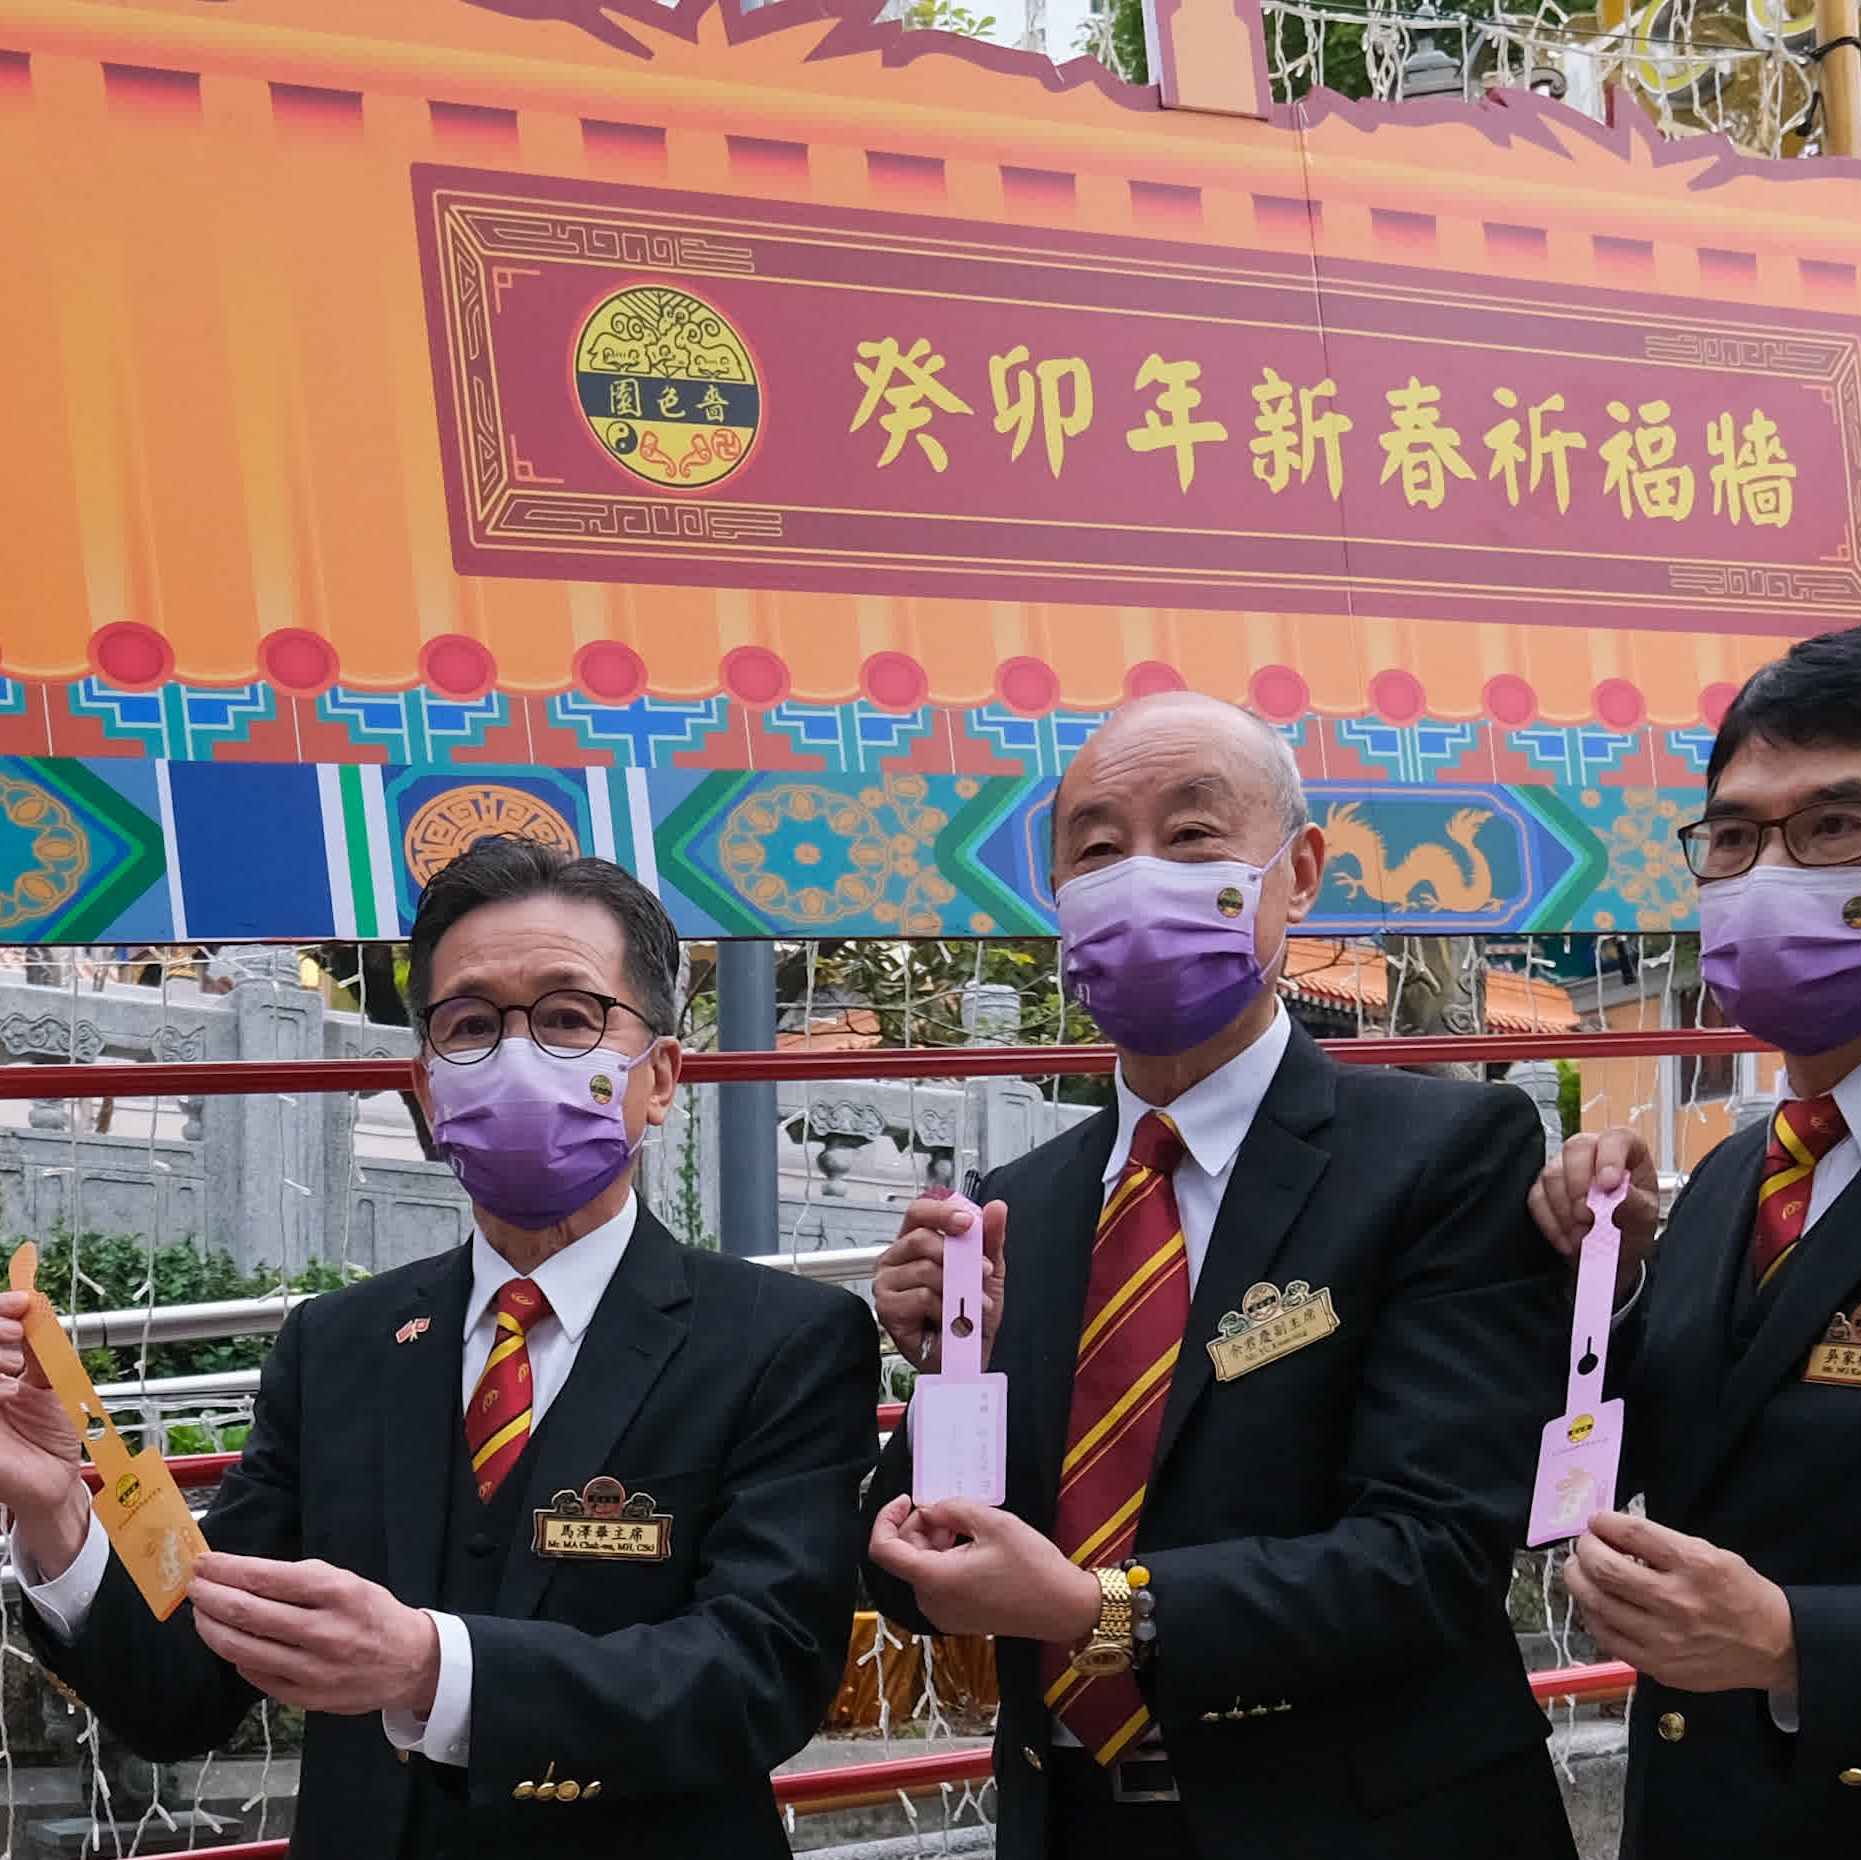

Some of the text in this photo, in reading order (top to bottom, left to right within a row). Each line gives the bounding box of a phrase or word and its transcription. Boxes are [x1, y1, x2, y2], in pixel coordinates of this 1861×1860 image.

[851, 334, 1800, 530] 癸卯年新春祈福牆
